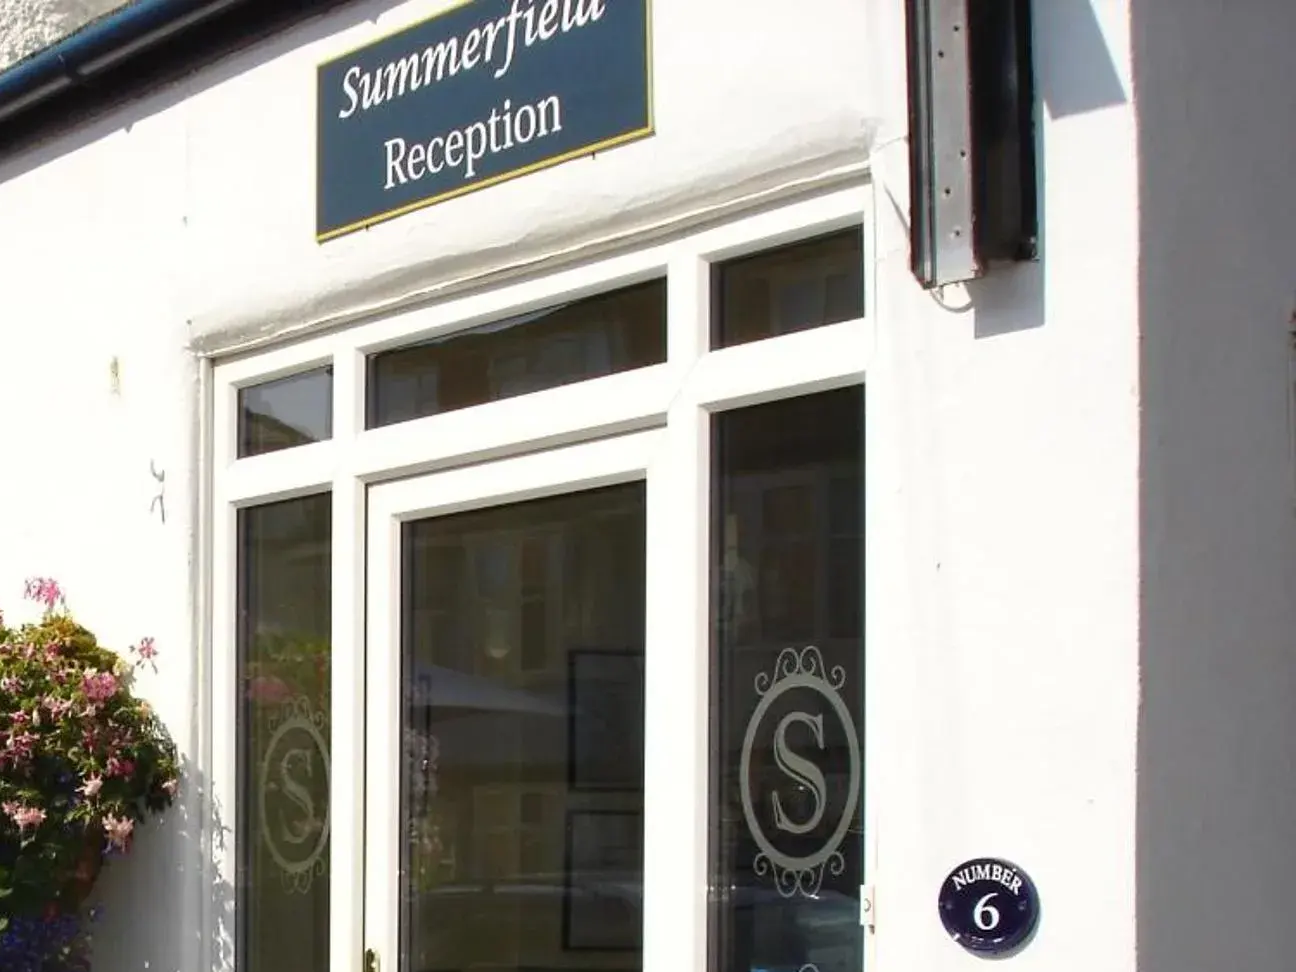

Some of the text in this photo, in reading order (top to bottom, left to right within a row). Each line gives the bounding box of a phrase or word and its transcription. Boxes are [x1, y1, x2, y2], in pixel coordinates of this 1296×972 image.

[383, 94, 563, 190] Reception
[772, 711, 826, 834] S
[952, 863, 1023, 896] NUMBER
[973, 892, 1000, 931] 6
